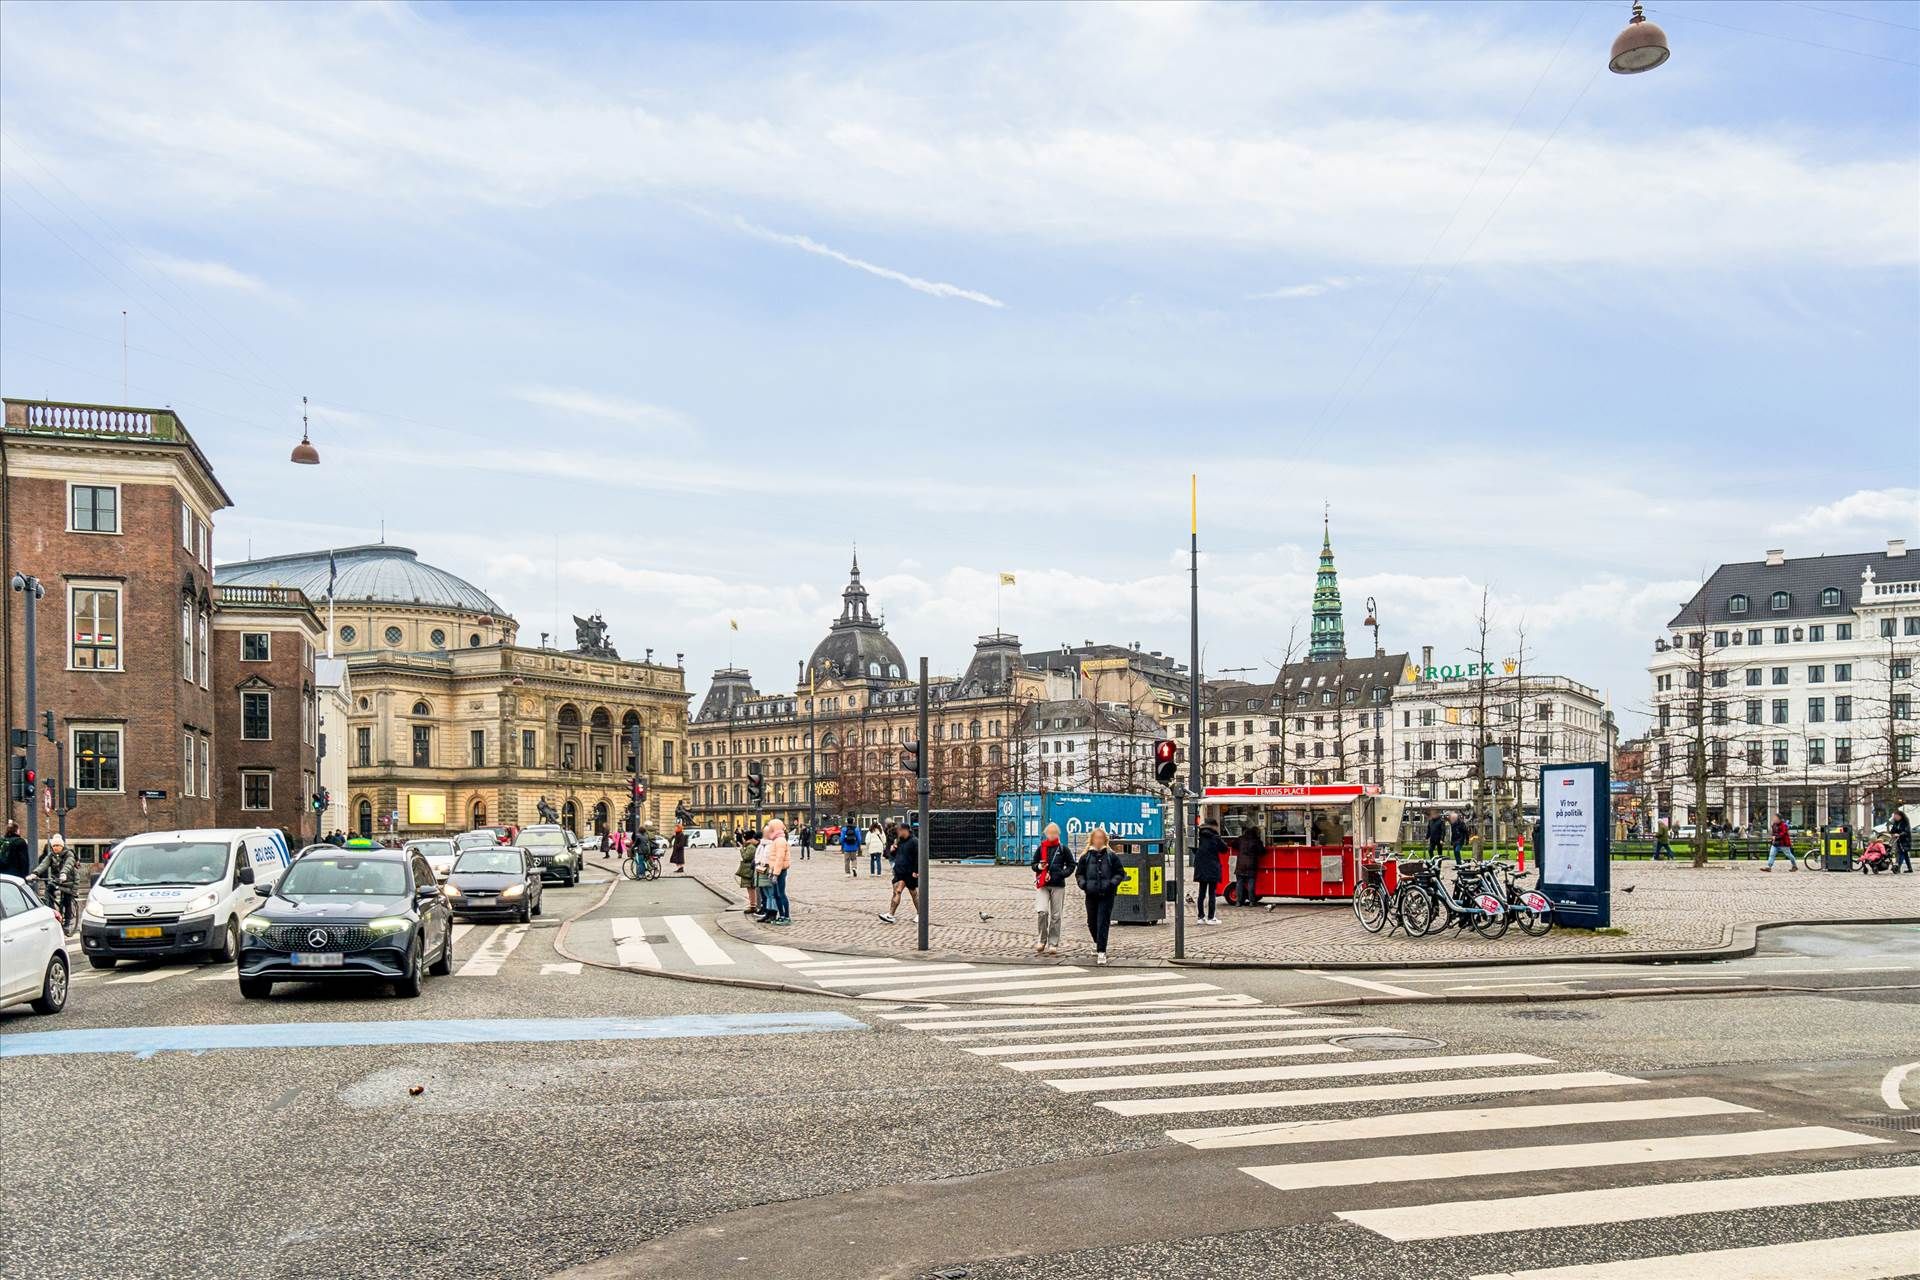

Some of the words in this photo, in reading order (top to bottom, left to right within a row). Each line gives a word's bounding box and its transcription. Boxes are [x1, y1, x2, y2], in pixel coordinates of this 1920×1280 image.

[1426, 662, 1494, 680] ROLEX
[1283, 787, 1304, 795] PLACE
[1556, 809, 1563, 818] på
[1564, 809, 1583, 818] politik
[1085, 821, 1144, 837] HANJIN
[117, 890, 182, 899] access
